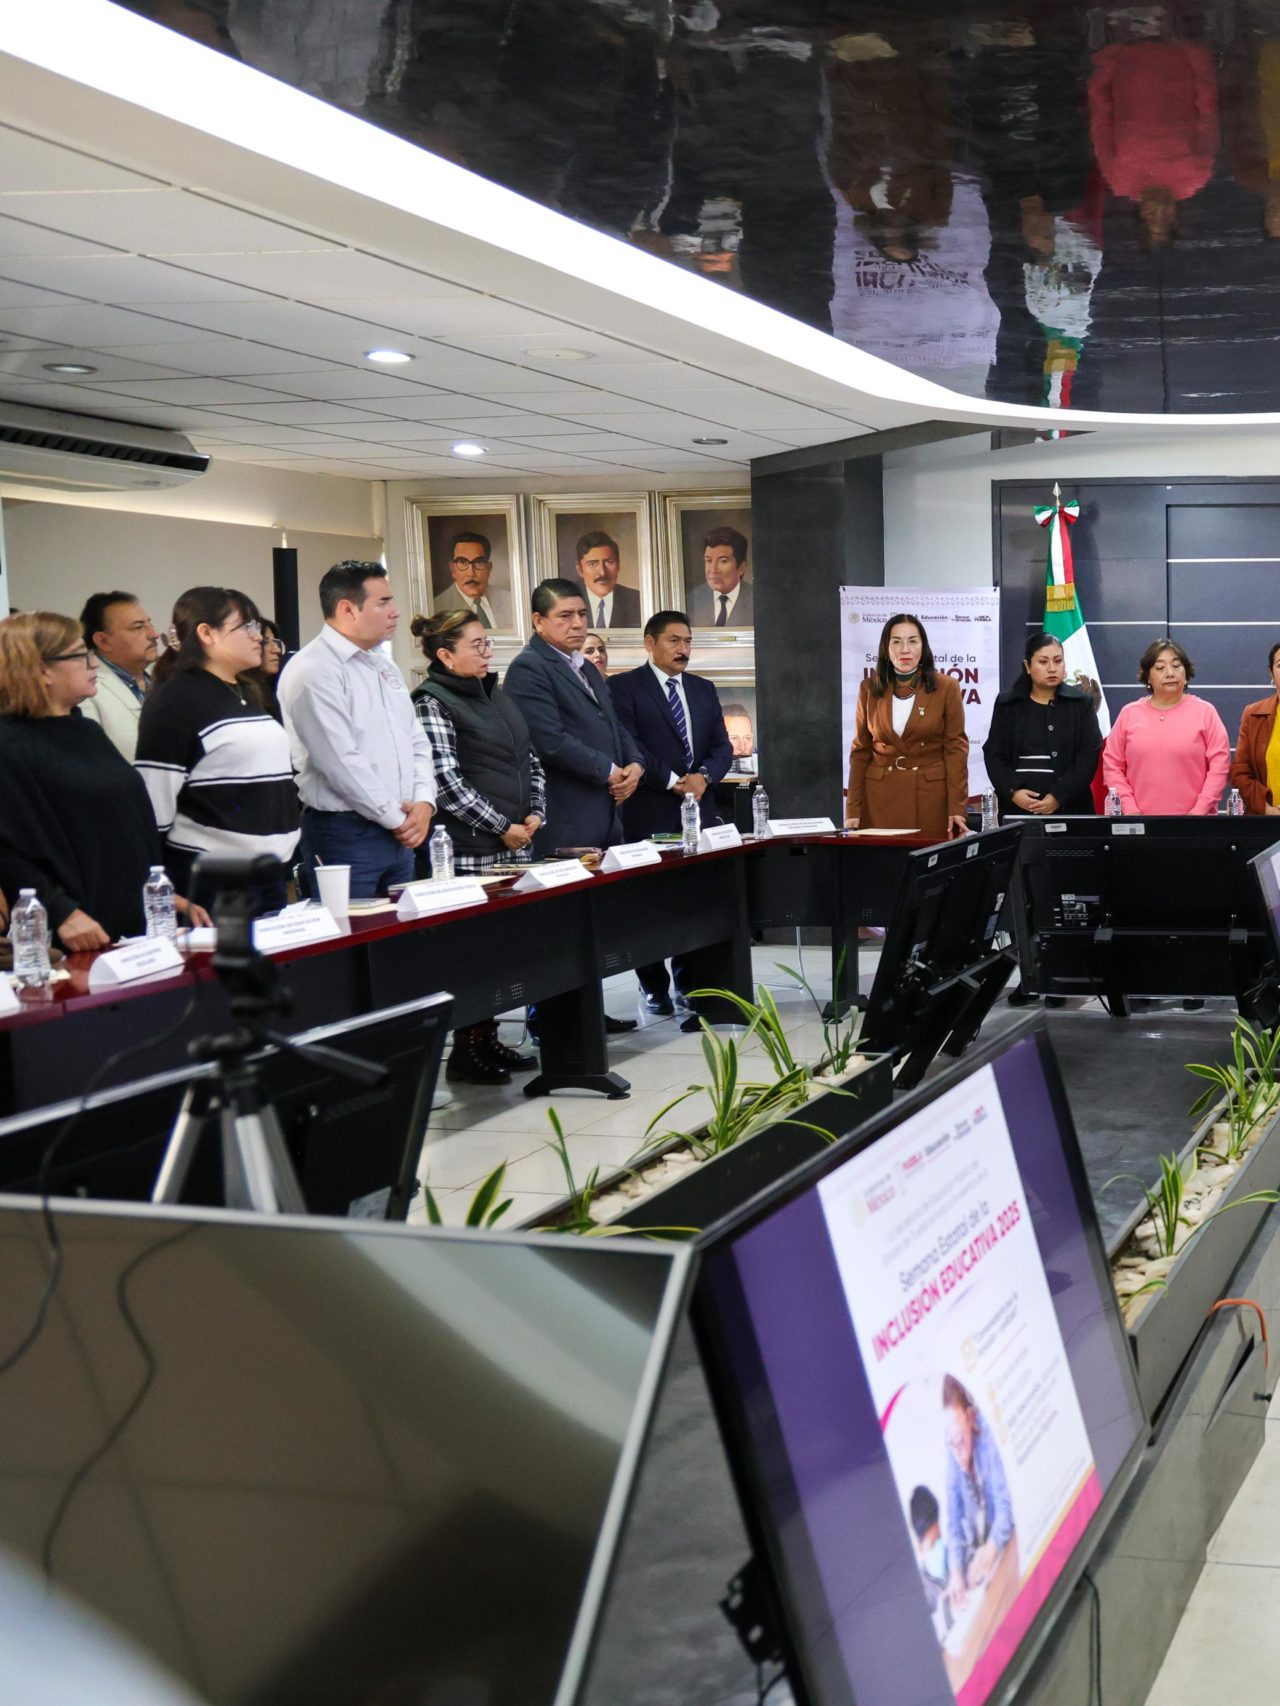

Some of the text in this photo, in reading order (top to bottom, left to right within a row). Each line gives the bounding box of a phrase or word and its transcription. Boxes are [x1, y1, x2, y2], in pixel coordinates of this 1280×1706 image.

[950, 654, 964, 663] de
[966, 654, 976, 662] la
[872, 1278, 941, 1362] INCLUSIÓN
[939, 1223, 999, 1295] EDUCATIVA
[997, 1199, 1021, 1238] 2025
